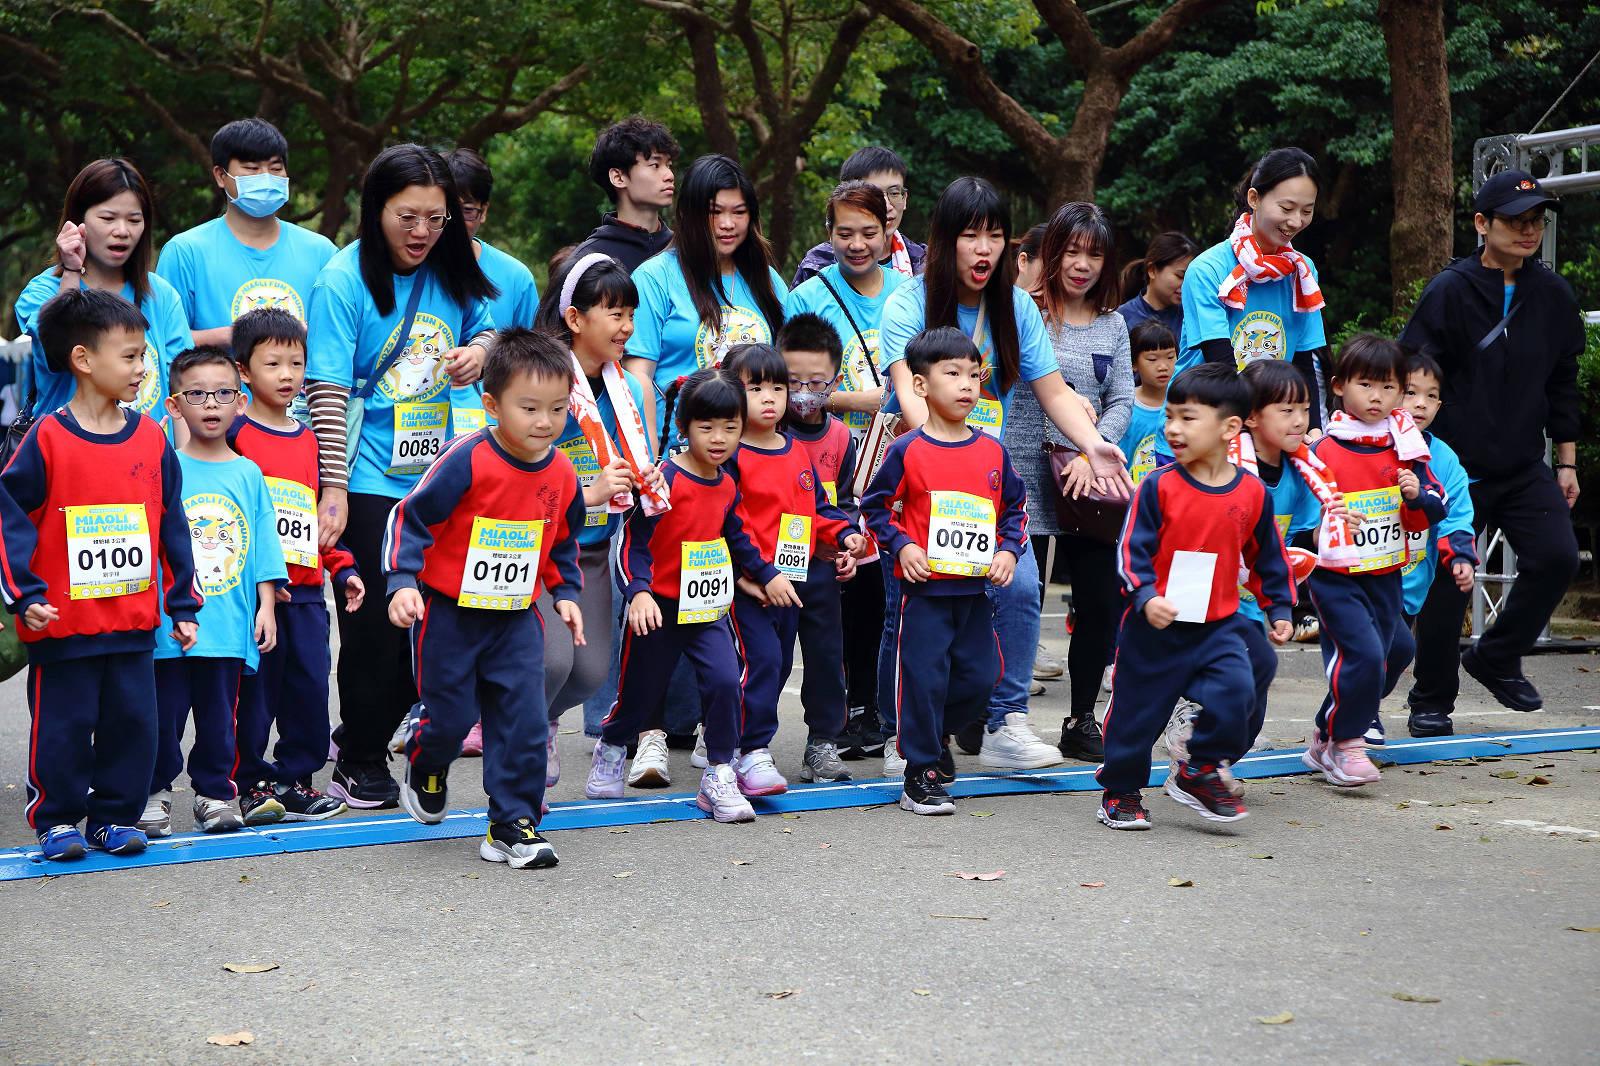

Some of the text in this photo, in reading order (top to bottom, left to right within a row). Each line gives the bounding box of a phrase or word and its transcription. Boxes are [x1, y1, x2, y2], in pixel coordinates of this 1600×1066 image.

[416, 315, 437, 327] FUN
[401, 410, 438, 421] MIAOLI
[401, 418, 442, 428] FUN YOUNG
[399, 437, 440, 458] 0083
[576, 463, 600, 472] YOUN
[286, 497, 312, 511] YOUNG
[938, 499, 982, 512] MIAOLI
[1348, 496, 1392, 510] MIAOLI
[1371, 503, 1399, 514] YOUNG
[75, 514, 128, 526] MIAOLI
[937, 507, 989, 520] FUN YOUNG
[75, 523, 139, 534] FUN YOUNG
[183, 495, 216, 510] IAOLI
[218, 496, 237, 515] FUN
[235, 512, 249, 551] YOUNG
[276, 517, 311, 542] 081
[480, 527, 528, 540] MIAOLI
[1353, 523, 1401, 547] 0075
[478, 538, 535, 548] FUN YOUNG
[936, 528, 989, 553] 0078
[78, 546, 143, 571] 0100
[689, 548, 723, 559] MIAOLI
[688, 556, 728, 567] FUN YOUNG
[778, 553, 806, 568] 0091
[473, 560, 529, 583] 0101
[687, 576, 728, 599] 0091
